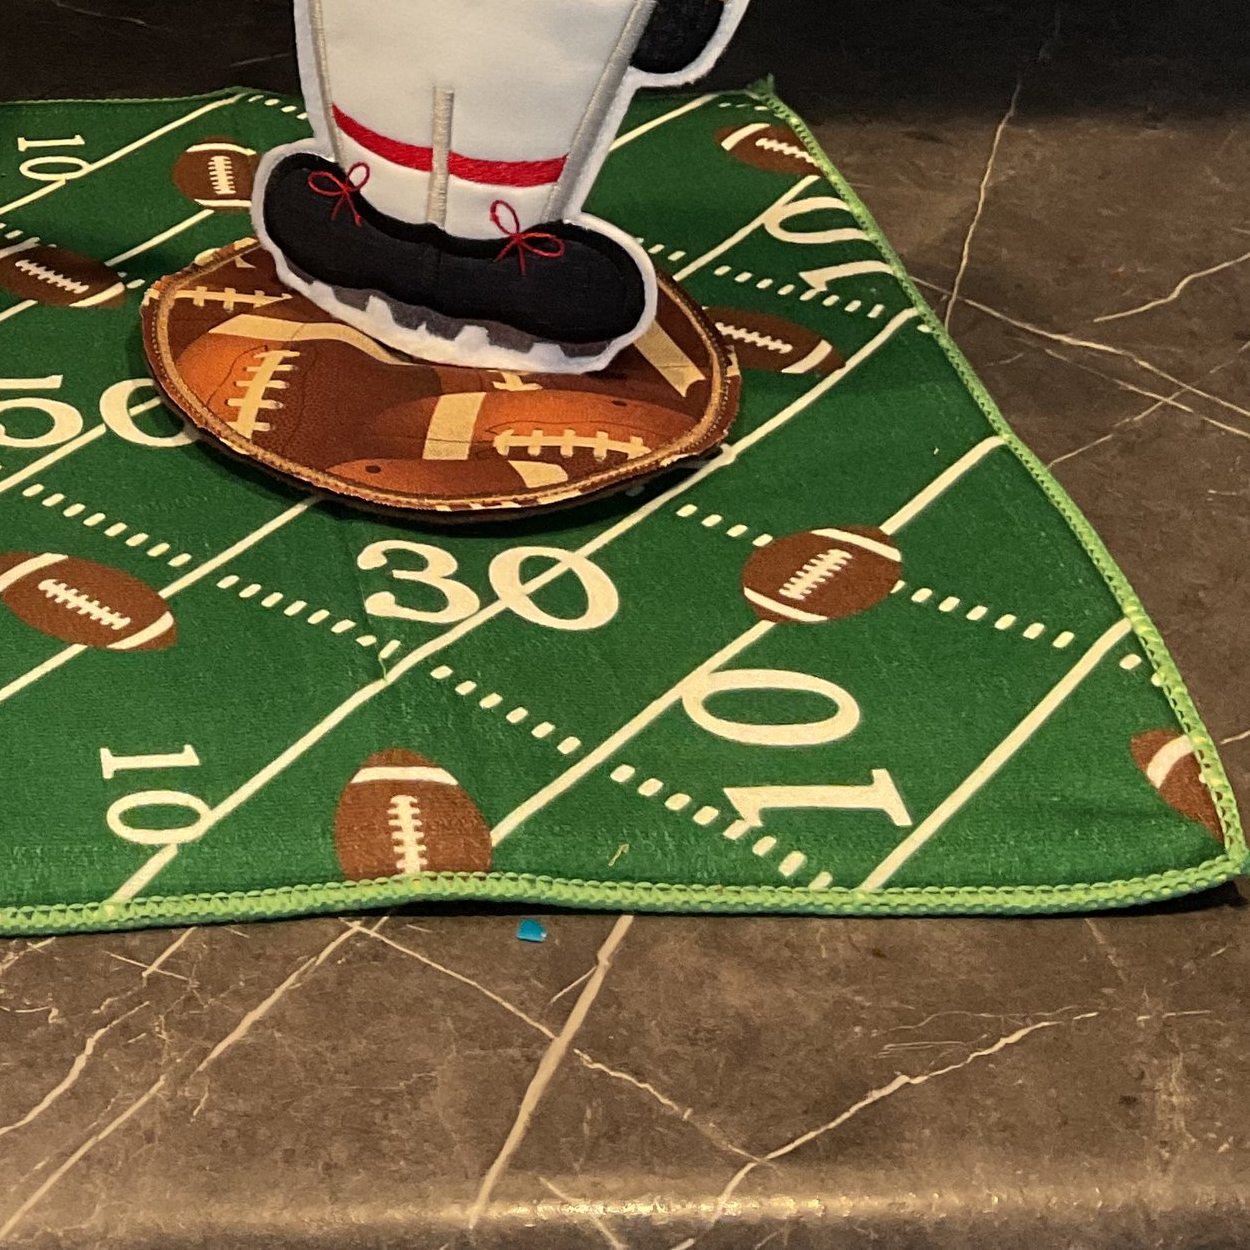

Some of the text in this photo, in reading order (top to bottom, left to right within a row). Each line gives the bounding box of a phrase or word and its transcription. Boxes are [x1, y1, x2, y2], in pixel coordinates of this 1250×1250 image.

[17, 135, 91, 181] 10
[357, 539, 619, 630] 30
[100, 744, 213, 845] 10
[681, 669, 913, 828] 10
